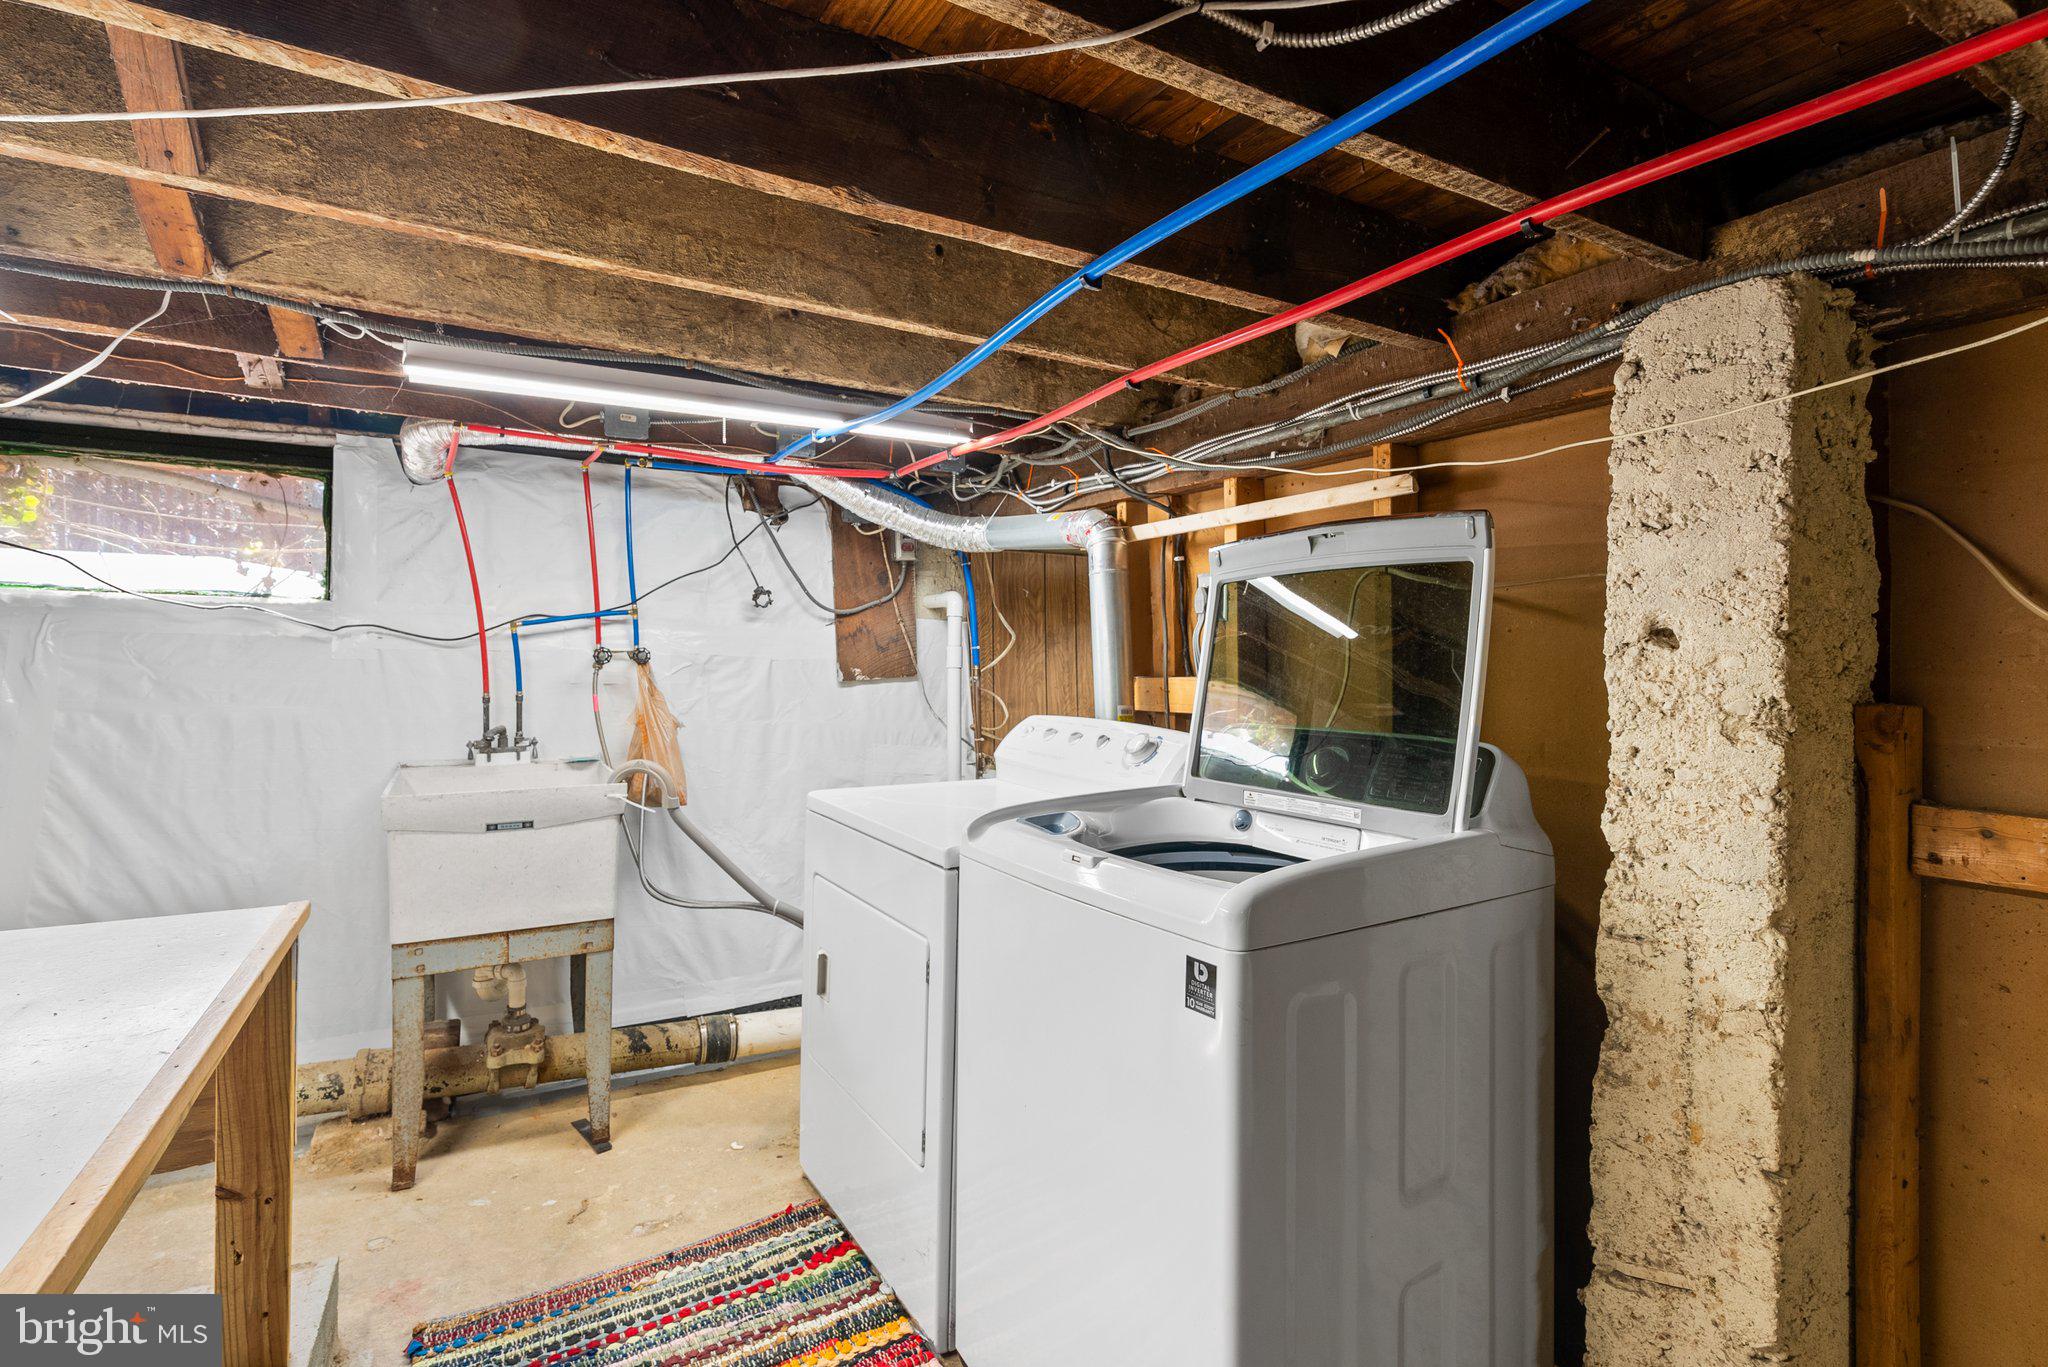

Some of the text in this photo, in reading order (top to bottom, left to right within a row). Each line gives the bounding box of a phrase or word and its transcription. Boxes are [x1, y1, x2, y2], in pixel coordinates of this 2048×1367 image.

[1188, 985, 1213, 998] INVERTER
[1190, 980, 1211, 992] DIGITAL
[1186, 996, 1195, 1008] 10
